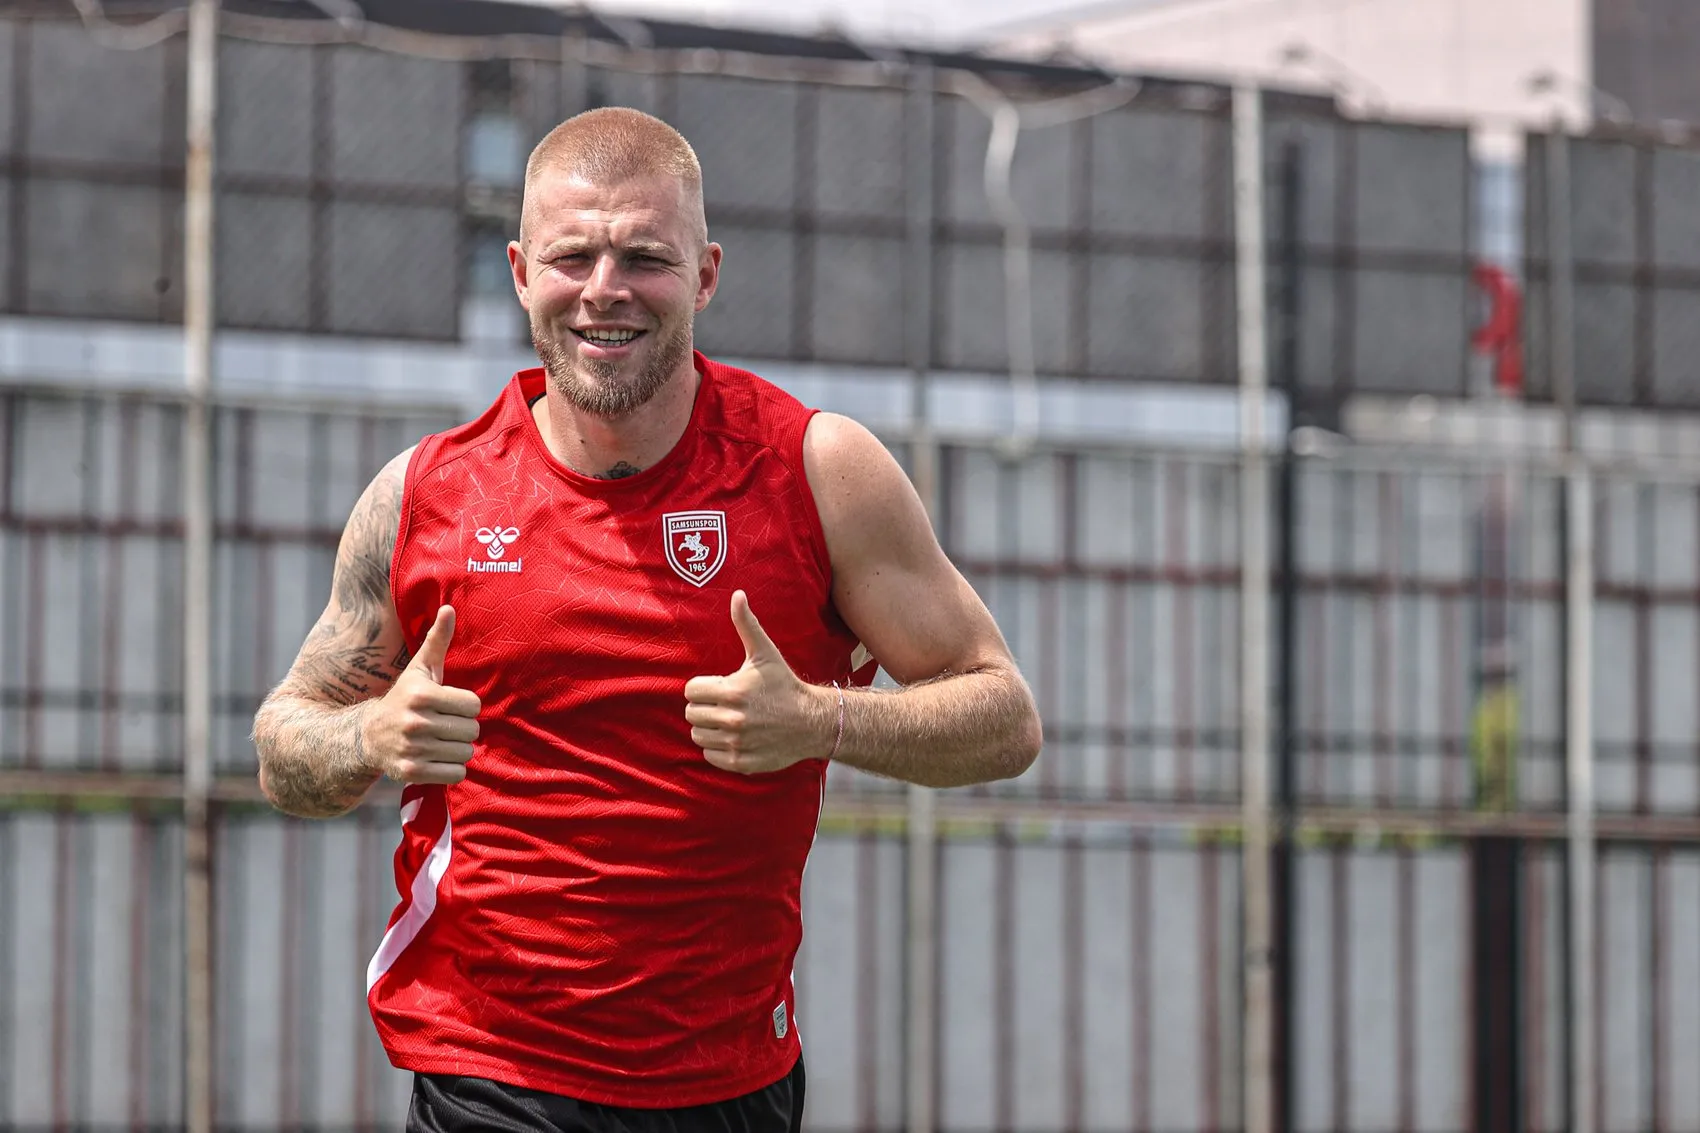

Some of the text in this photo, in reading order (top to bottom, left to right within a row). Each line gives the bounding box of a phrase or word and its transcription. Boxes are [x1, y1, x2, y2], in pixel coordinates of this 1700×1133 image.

[671, 520, 718, 530] SAMSUNSPOR
[467, 557, 522, 573] hummel
[688, 562, 707, 573] 1965
